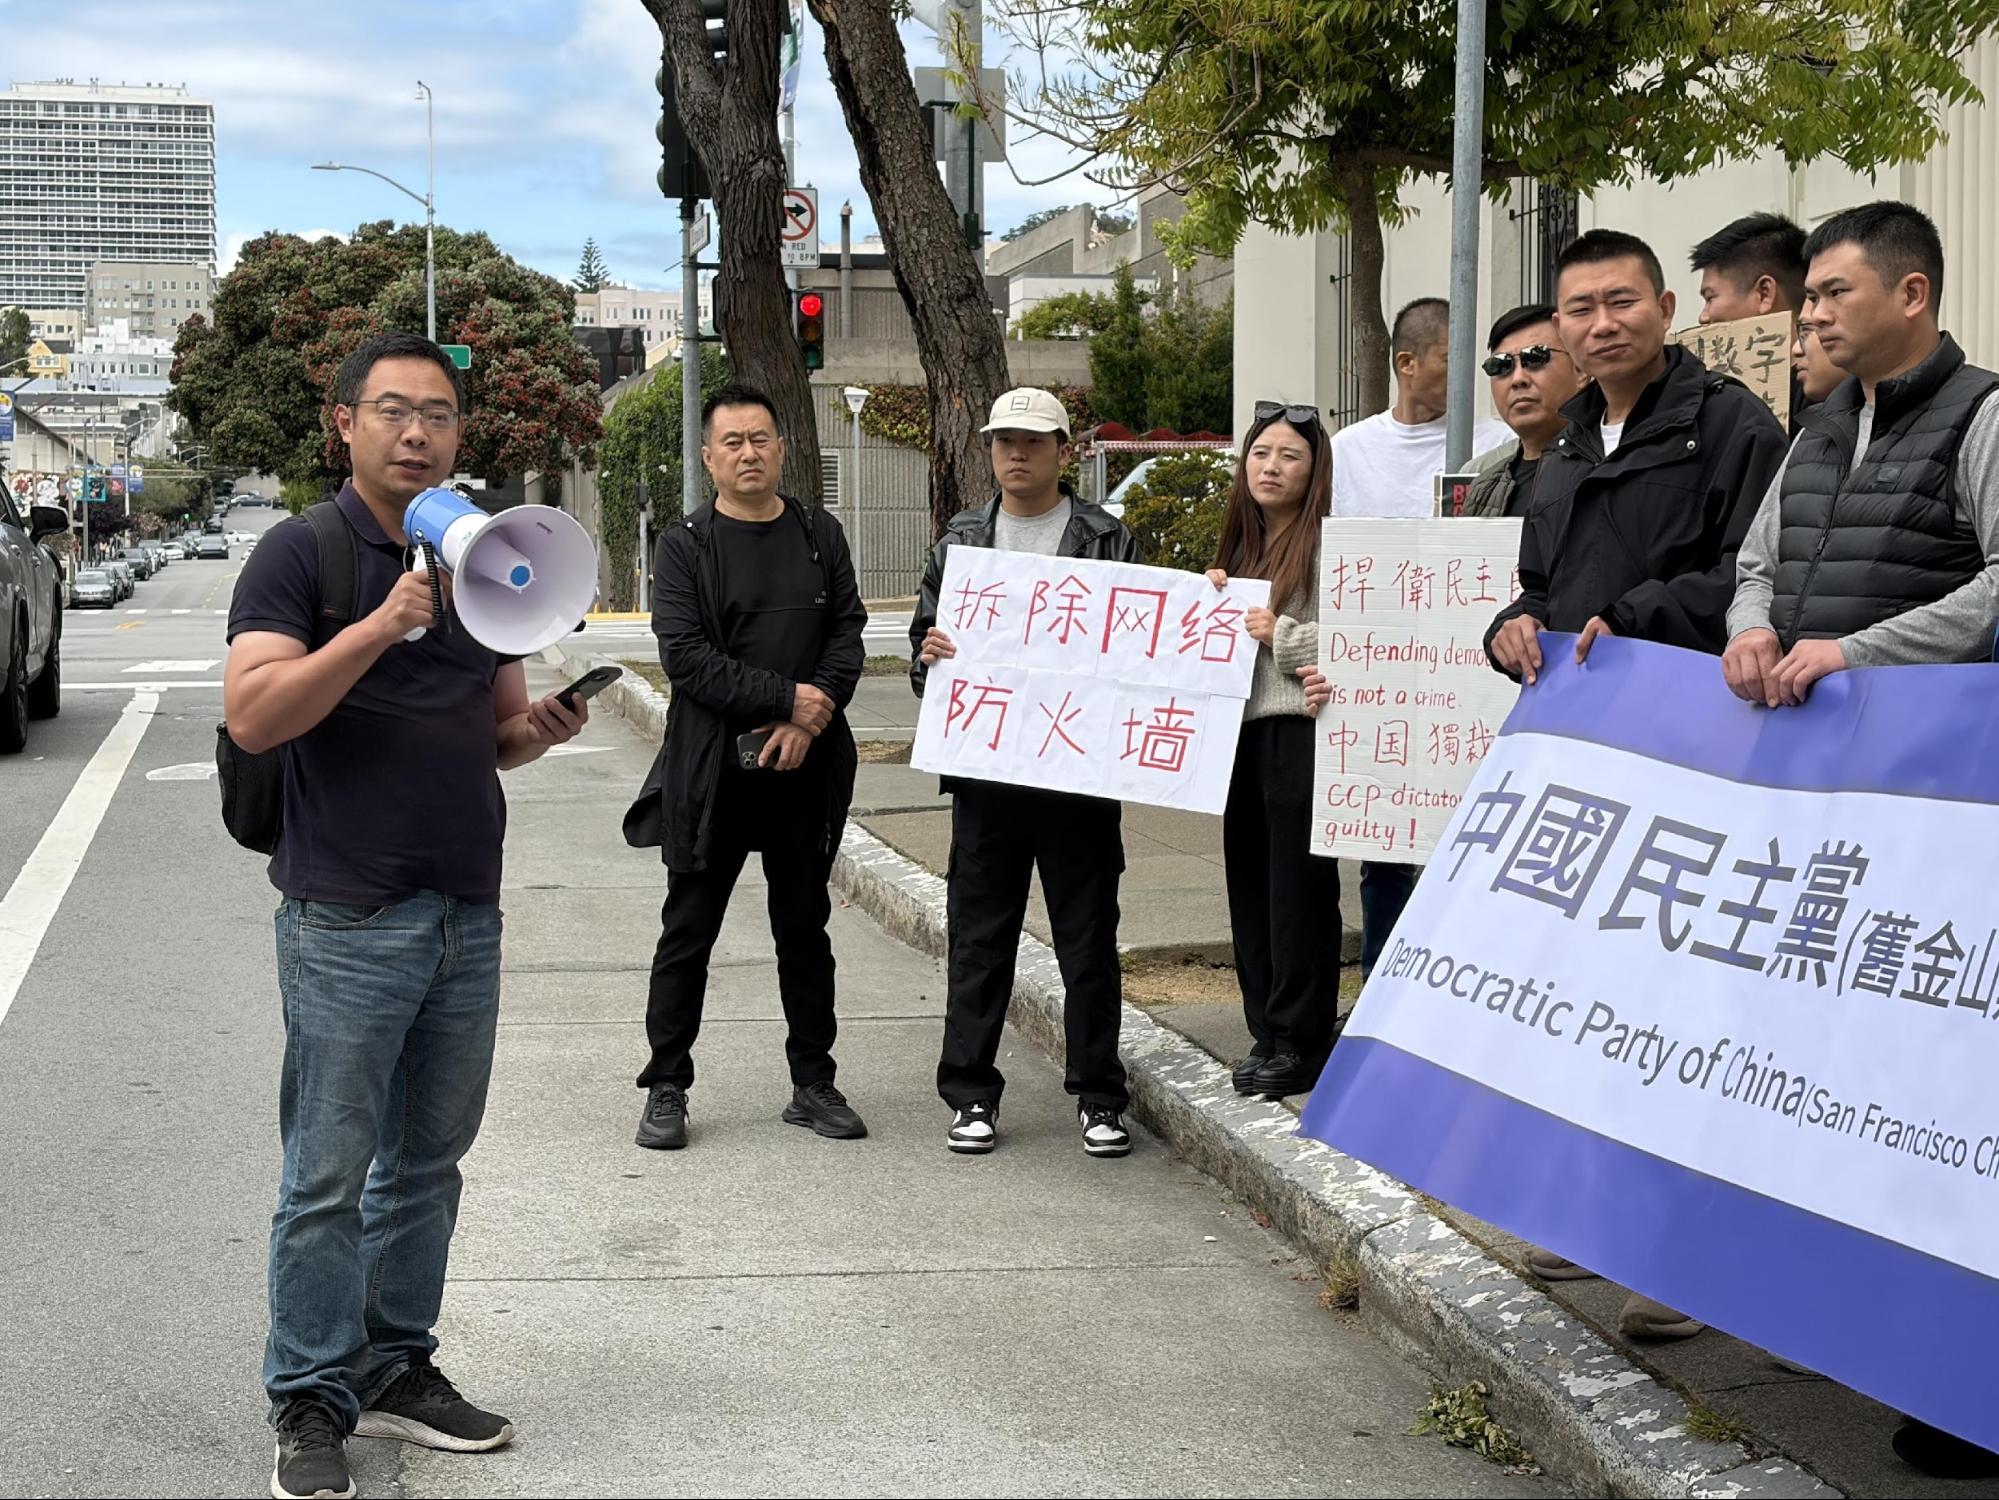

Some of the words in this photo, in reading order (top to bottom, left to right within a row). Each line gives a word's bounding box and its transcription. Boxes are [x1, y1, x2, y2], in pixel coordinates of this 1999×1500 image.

[791, 243, 806, 251] RED
[954, 574, 1244, 663] 拆除网络
[1330, 631, 1438, 674] Defending
[944, 676, 1196, 773] 防火墙
[1332, 684, 1347, 705] is
[1354, 684, 1386, 706] not
[1395, 689, 1407, 704] a
[1415, 688, 1462, 710] crime.
[1328, 783, 1381, 817] CCP
[1448, 770, 1999, 1020] 中國民主黨(舊金山
[1381, 937, 1574, 1037] Democratic
[1574, 1000, 1679, 1087] Party
[1677, 1037, 1732, 1090] of
[1858, 1103, 1968, 1169] Francisco
